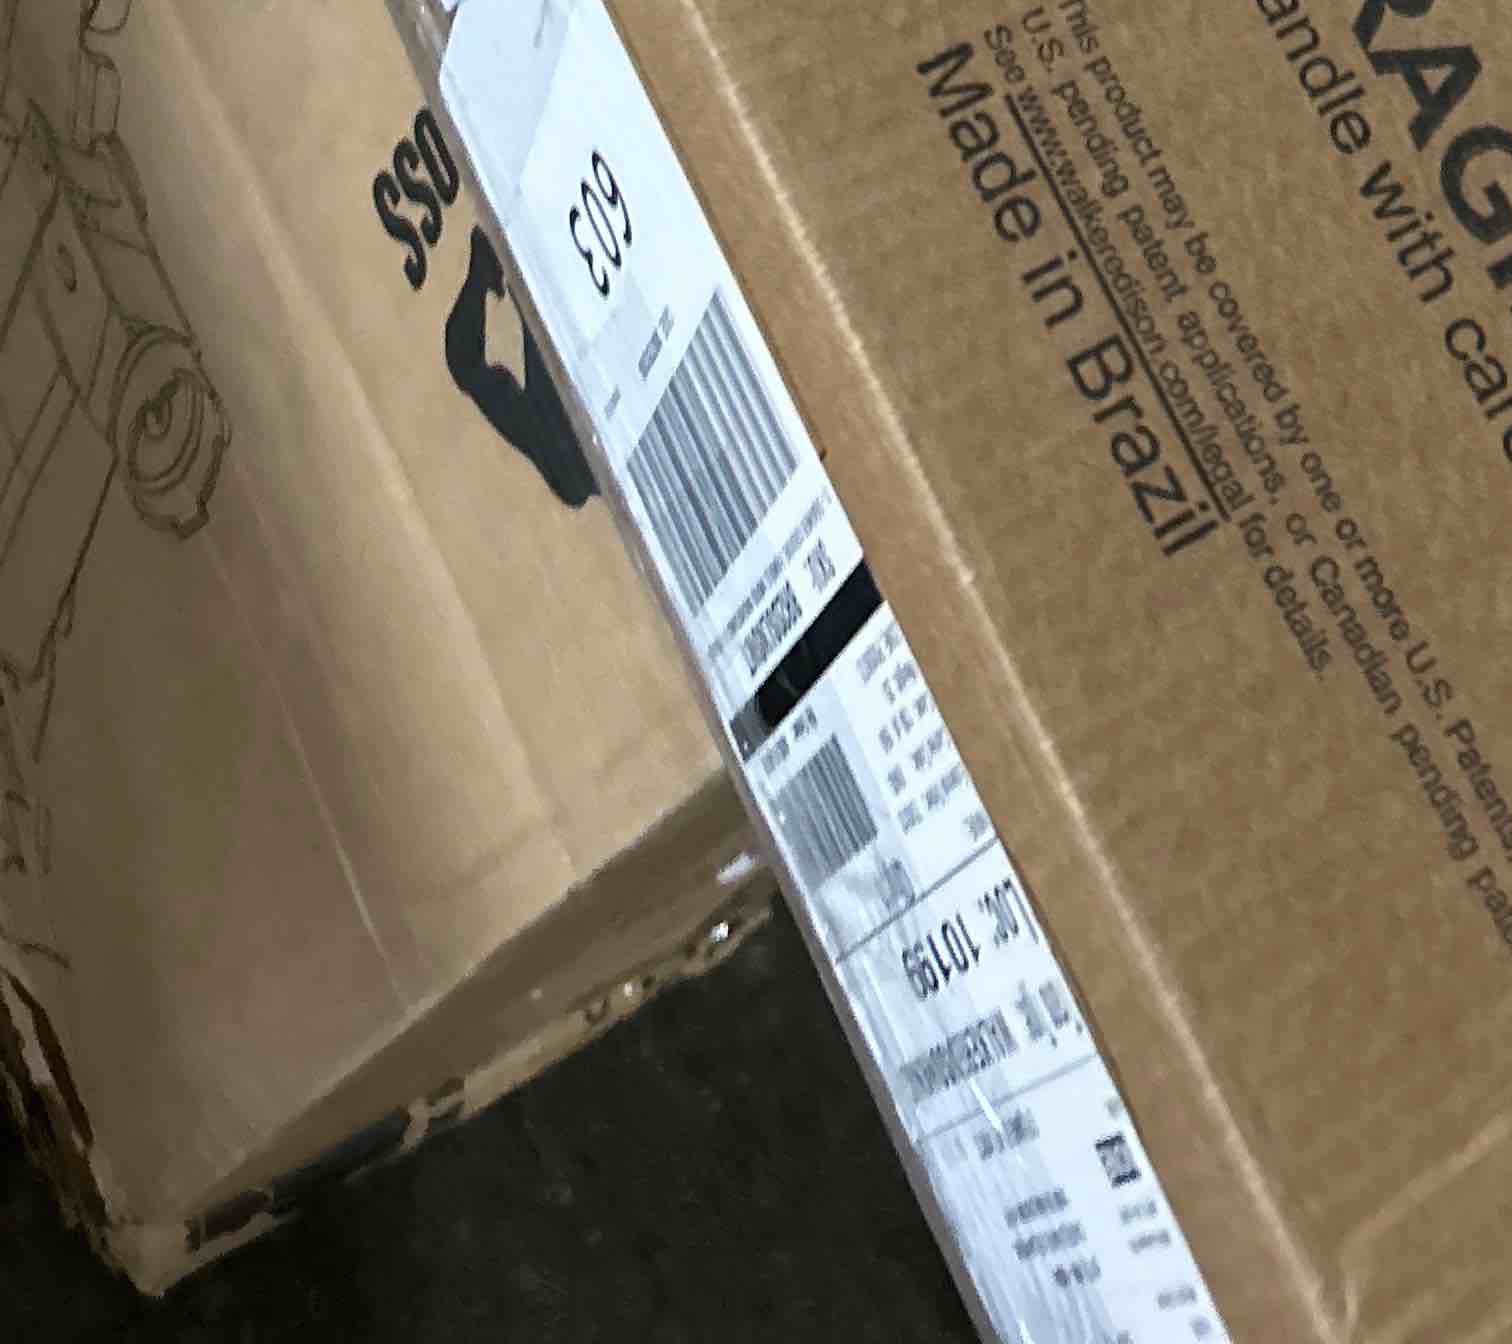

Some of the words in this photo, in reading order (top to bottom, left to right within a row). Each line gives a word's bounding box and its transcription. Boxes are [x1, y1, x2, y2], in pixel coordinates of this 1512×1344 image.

[569, 150, 633, 297] 603
[916, 42, 1068, 243] Made
[1021, 250, 1083, 330] in
[1065, 334, 1219, 558] Brazil
[984, 24, 1024, 82] See
[1239, 513, 1274, 558] for
[1051, 80, 1128, 198] pending
[1117, 205, 1188, 302] patent
[1286, 513, 1317, 544] or
[1309, 556, 1401, 715] Canadian
[1389, 723, 1479, 861] pending
[1084, 56, 1163, 166] product
[1148, 165, 1194, 229] may
[1184, 232, 1216, 275] be
[1208, 281, 1289, 402] covered
[1274, 403, 1310, 446] by
[1300, 452, 1341, 512] one
[1336, 518, 1368, 550] or
[1354, 556, 1409, 641] more
[1406, 640, 1452, 720] U.S.
[1360, 160, 1454, 303] with
